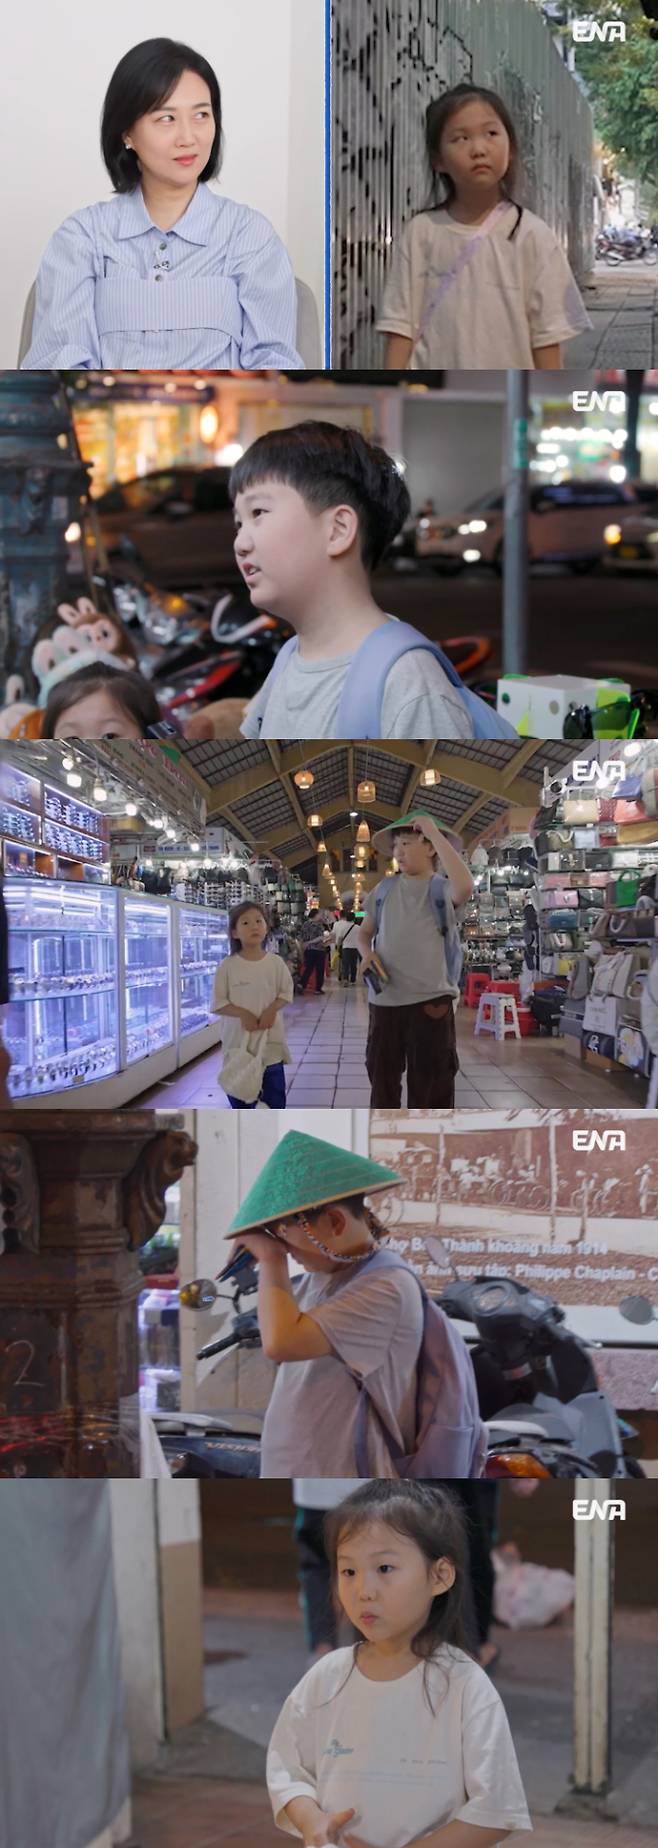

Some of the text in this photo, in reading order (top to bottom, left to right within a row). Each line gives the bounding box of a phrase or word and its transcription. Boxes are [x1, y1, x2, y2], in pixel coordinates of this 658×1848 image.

[576, 1240, 608, 1255] 1914
[515, 1264, 571, 1281] Philippe
[575, 1265, 636, 1282] Chaplain
[4, 1339, 46, 1387] 2
